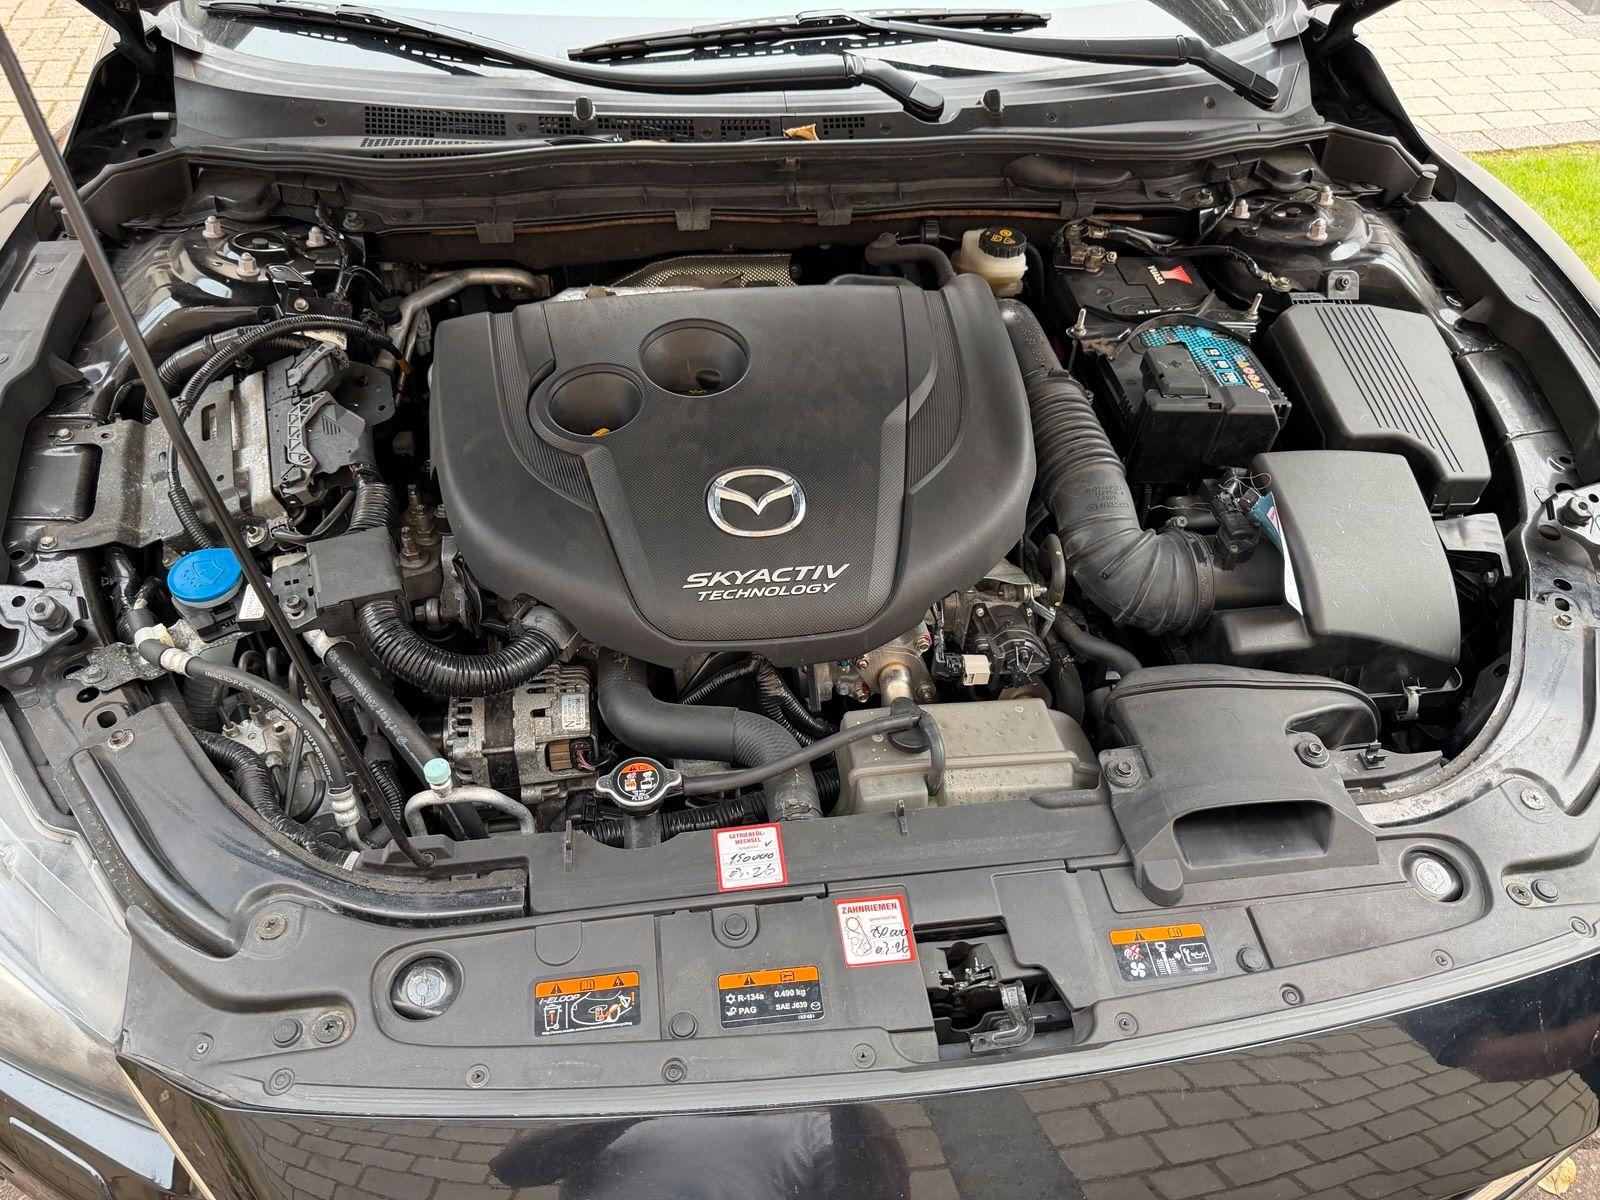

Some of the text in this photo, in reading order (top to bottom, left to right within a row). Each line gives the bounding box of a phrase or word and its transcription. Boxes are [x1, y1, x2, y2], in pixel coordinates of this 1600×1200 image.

[1147, 265, 1166, 285] YUASA
[682, 563, 850, 589] SKYACTIV
[697, 582, 837, 602] TECHNOLOGY
[728, 830, 766, 840] GETRIEBEÖL-
[734, 837, 761, 845] WECHSEL
[841, 902, 898, 914] ZAHNRIEMEN
[737, 992, 765, 1002] R-134a
[796, 988, 806, 997] kg
[738, 1001, 808, 1015] PAG SAE J639
